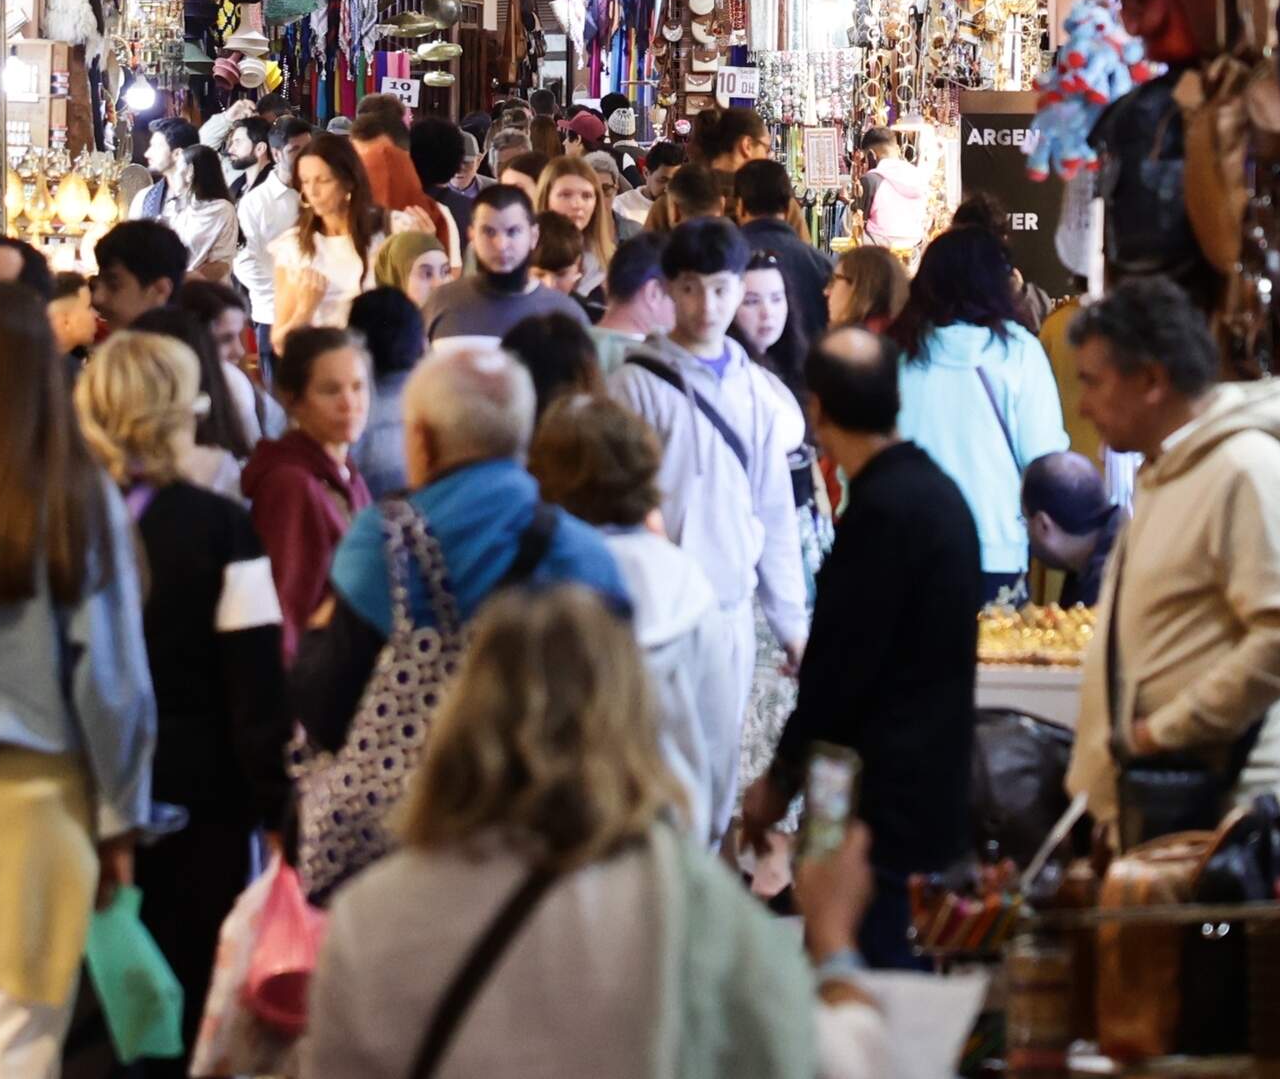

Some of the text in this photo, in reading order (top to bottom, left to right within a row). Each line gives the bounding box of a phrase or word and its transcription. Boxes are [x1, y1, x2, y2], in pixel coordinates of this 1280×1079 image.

[389, 81, 411, 91] 10
[719, 72, 736, 93] 10
[399, 93, 412, 103] H
[967, 128, 1041, 146] ARGEN
